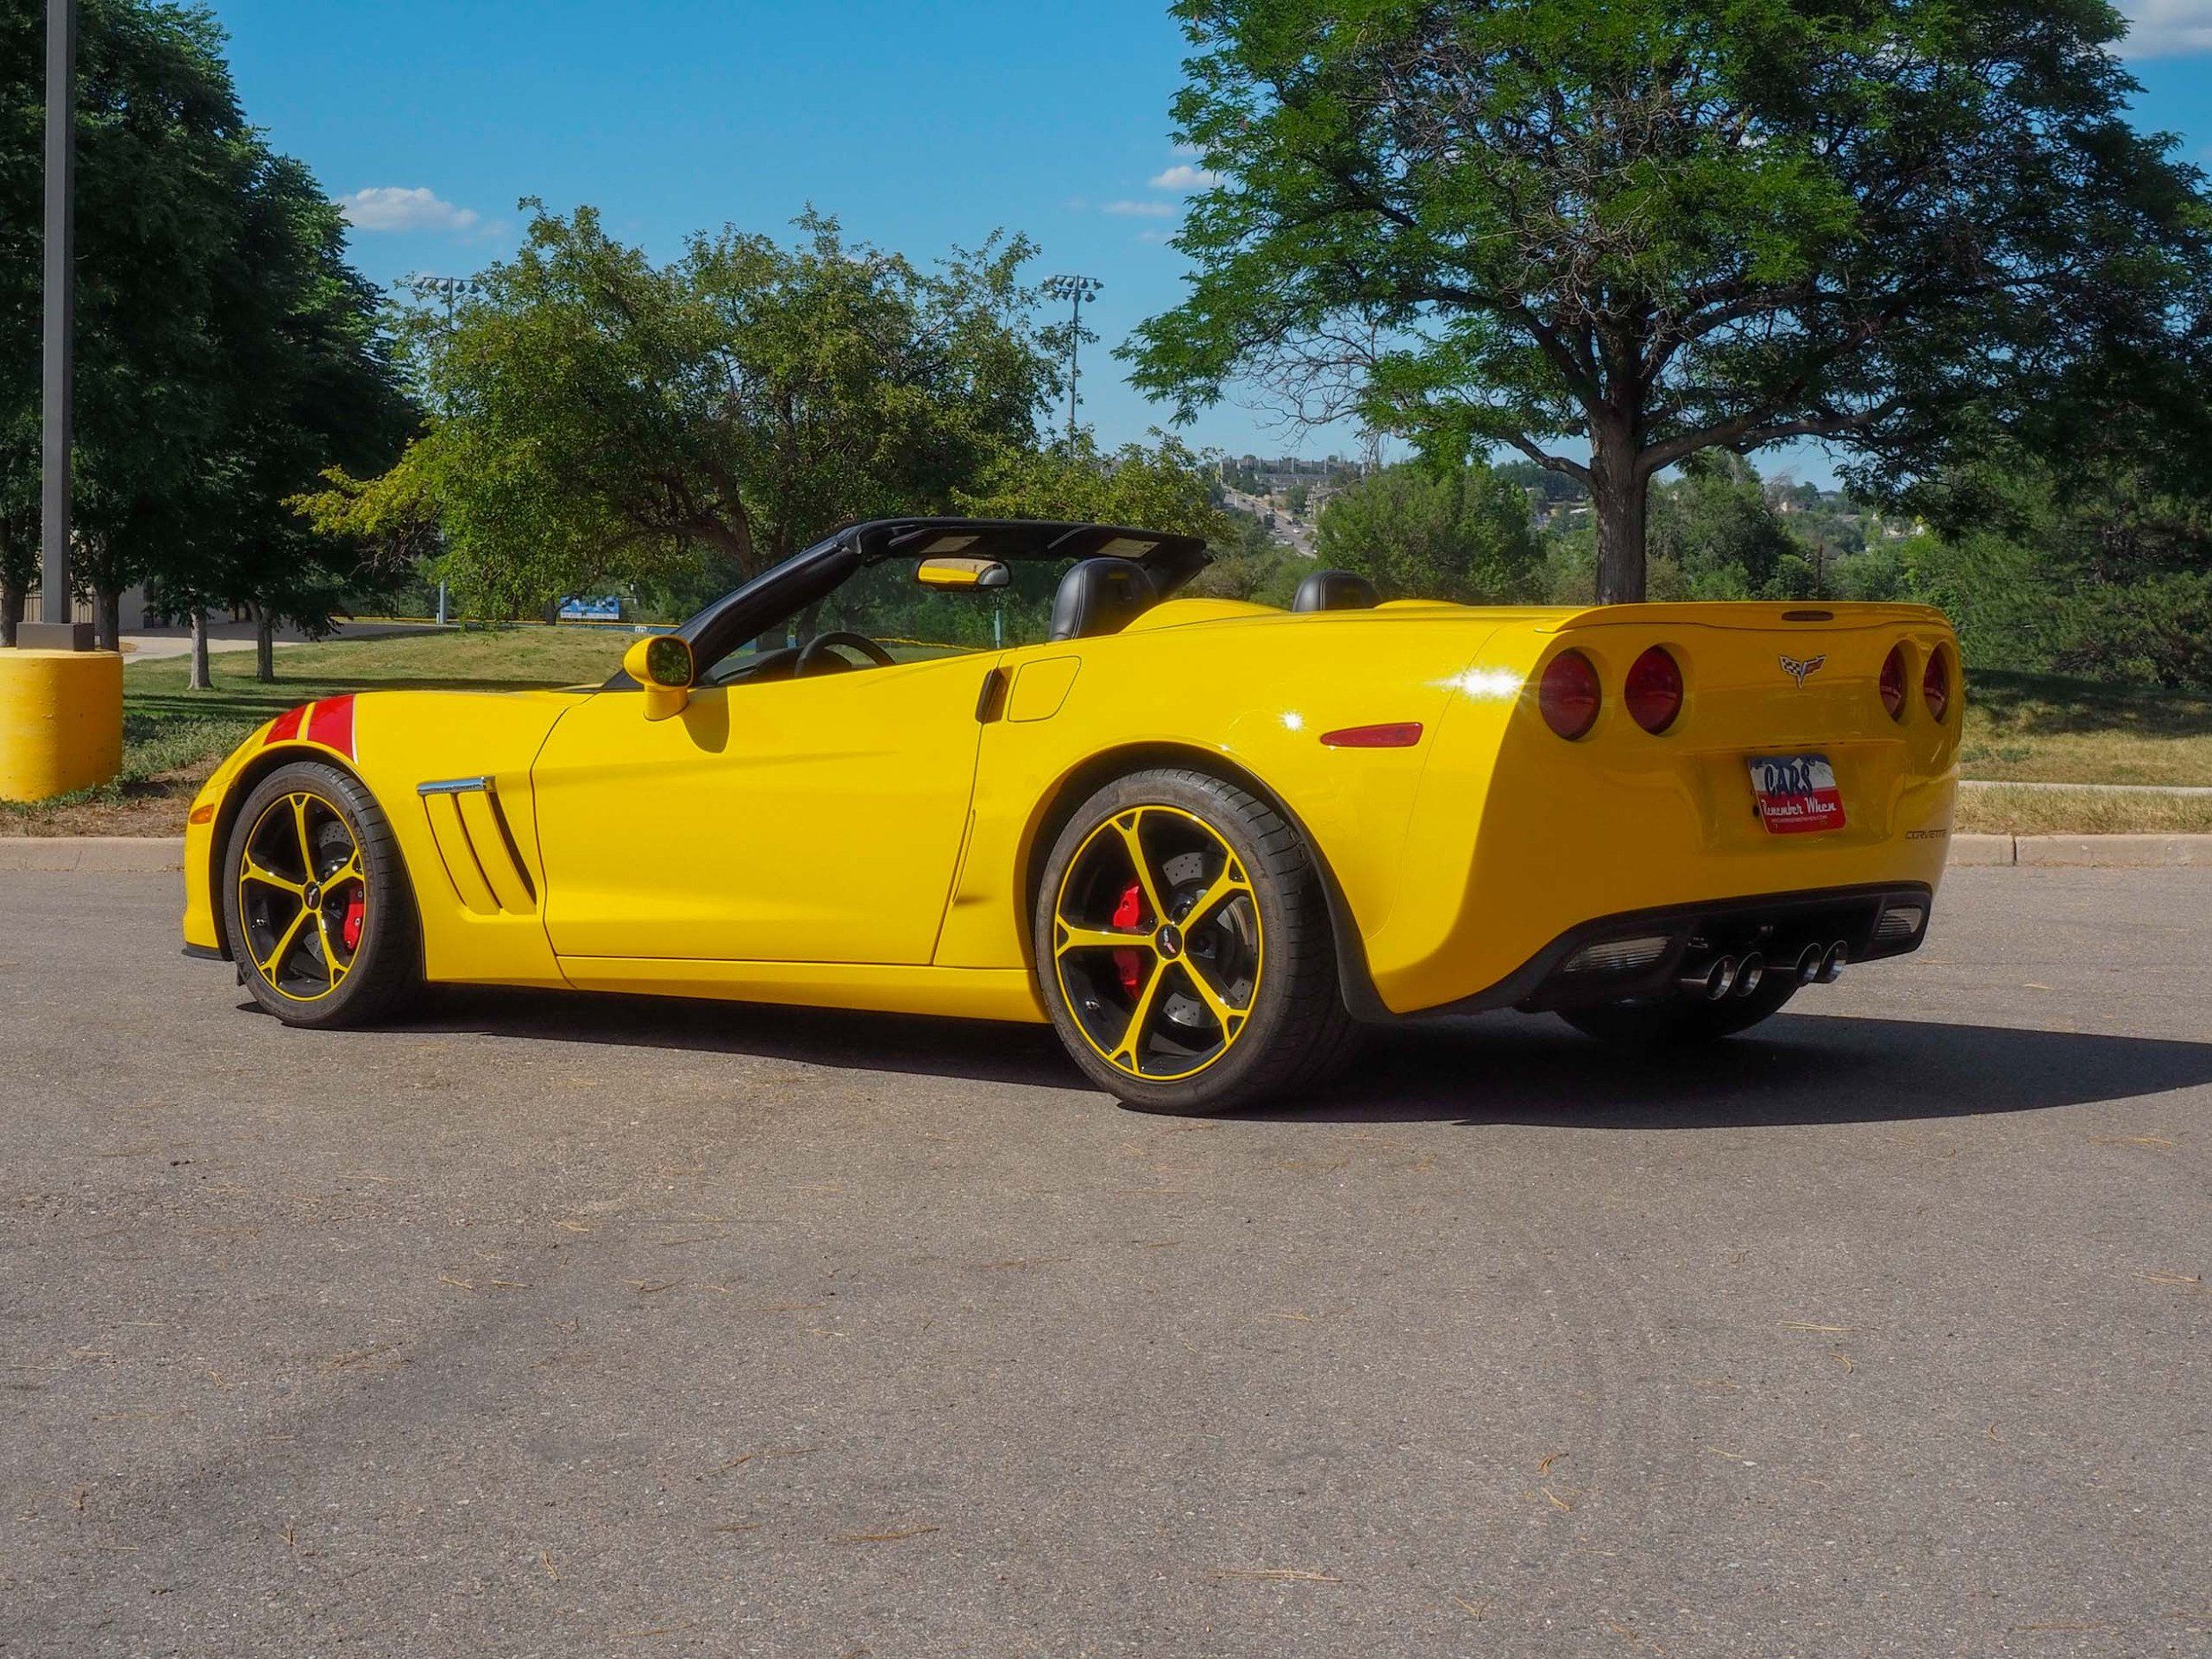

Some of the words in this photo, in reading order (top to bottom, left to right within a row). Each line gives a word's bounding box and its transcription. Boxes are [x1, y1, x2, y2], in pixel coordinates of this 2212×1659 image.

[1764, 763, 1813, 797] CARS
[1761, 798, 1804, 816] Remember
[1804, 796, 1837, 813] When
